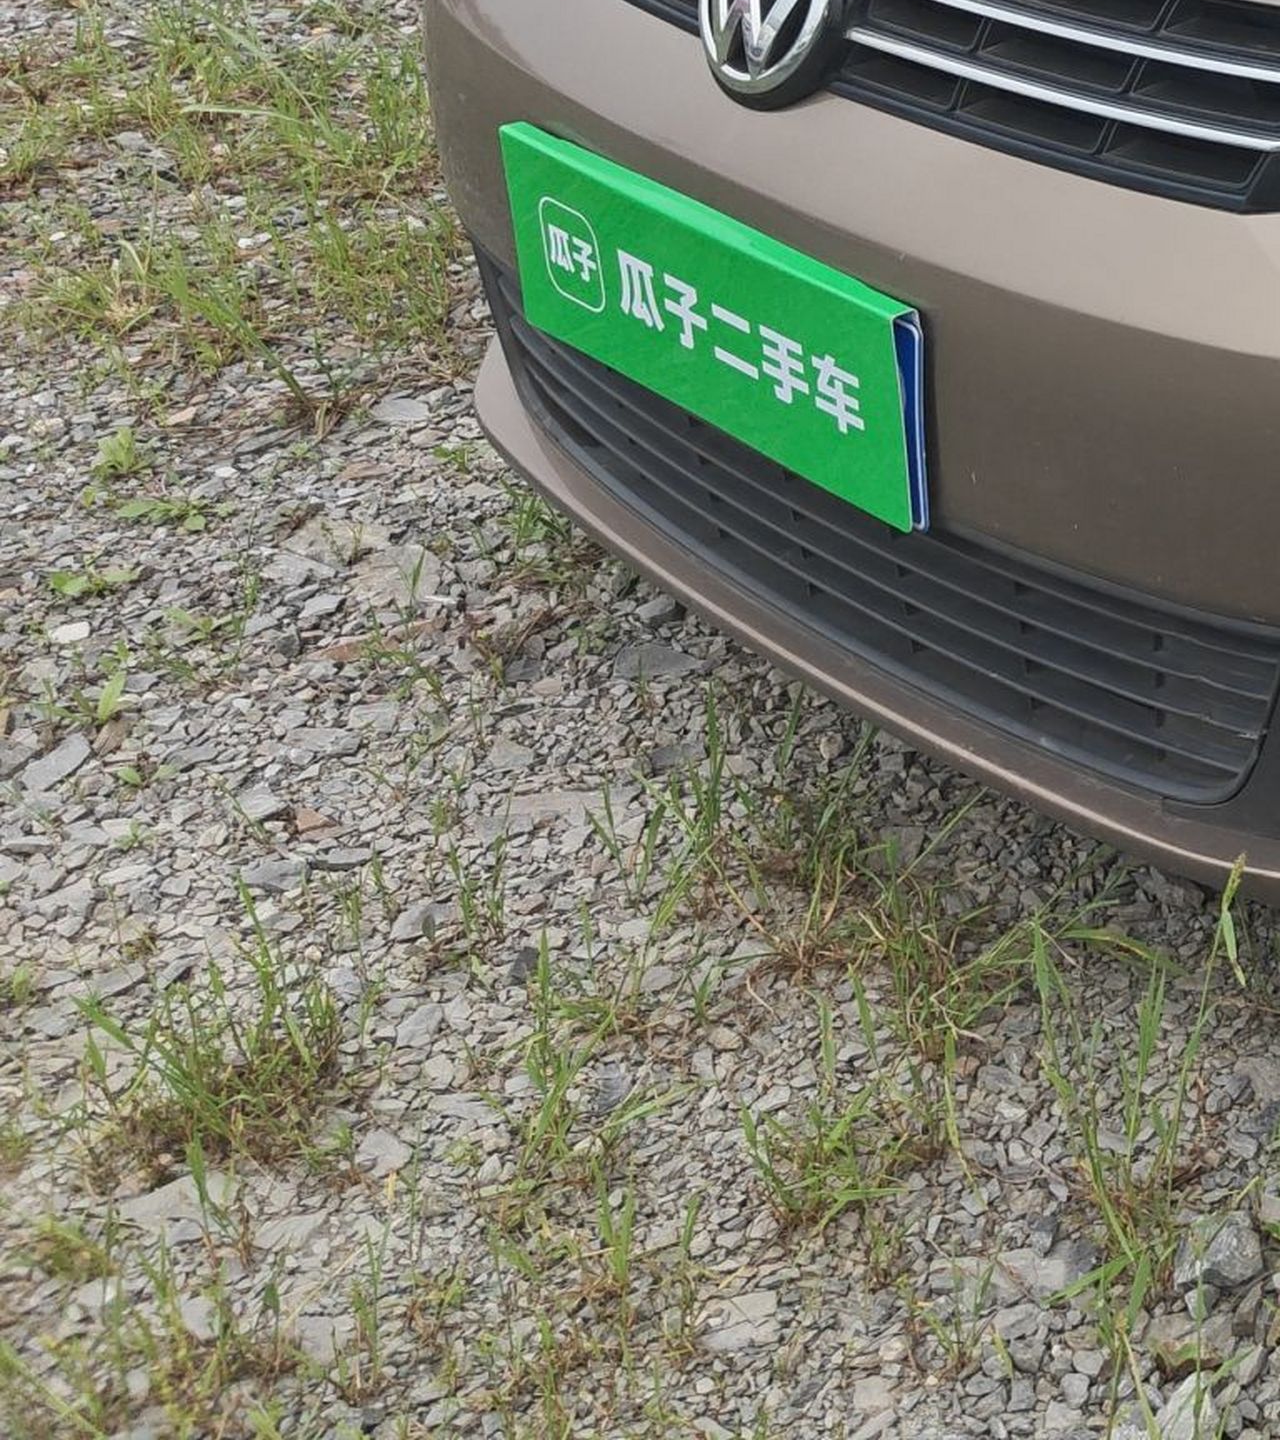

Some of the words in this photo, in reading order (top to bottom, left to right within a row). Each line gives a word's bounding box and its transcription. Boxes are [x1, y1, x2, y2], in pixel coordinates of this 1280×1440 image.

[547, 223, 597, 283] 瓜子
[616, 249, 866, 435] 瓜子二手车
